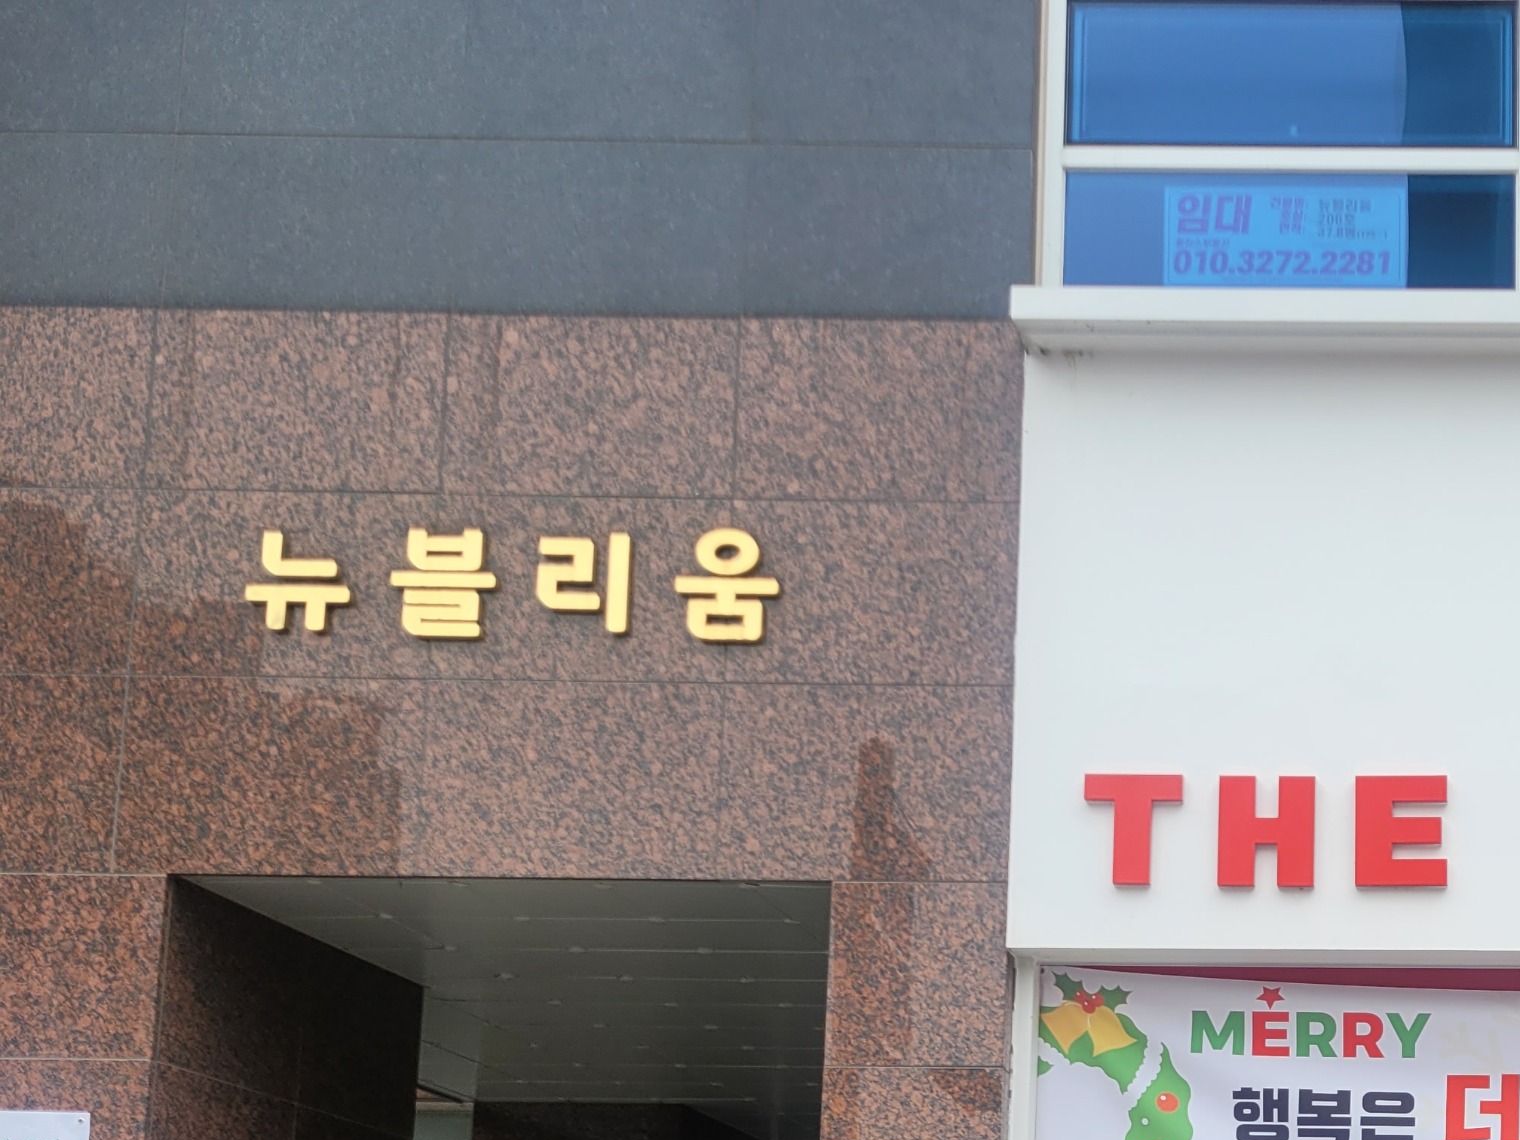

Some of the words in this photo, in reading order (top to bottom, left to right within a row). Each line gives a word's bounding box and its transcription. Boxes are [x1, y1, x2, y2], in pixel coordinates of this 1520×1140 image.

[1177, 194, 1252, 234] 임대
[1173, 250, 1391, 275] 010.3272.2281
[1084, 773, 1448, 893] THE
[1190, 1009, 1432, 1059] MERRY
